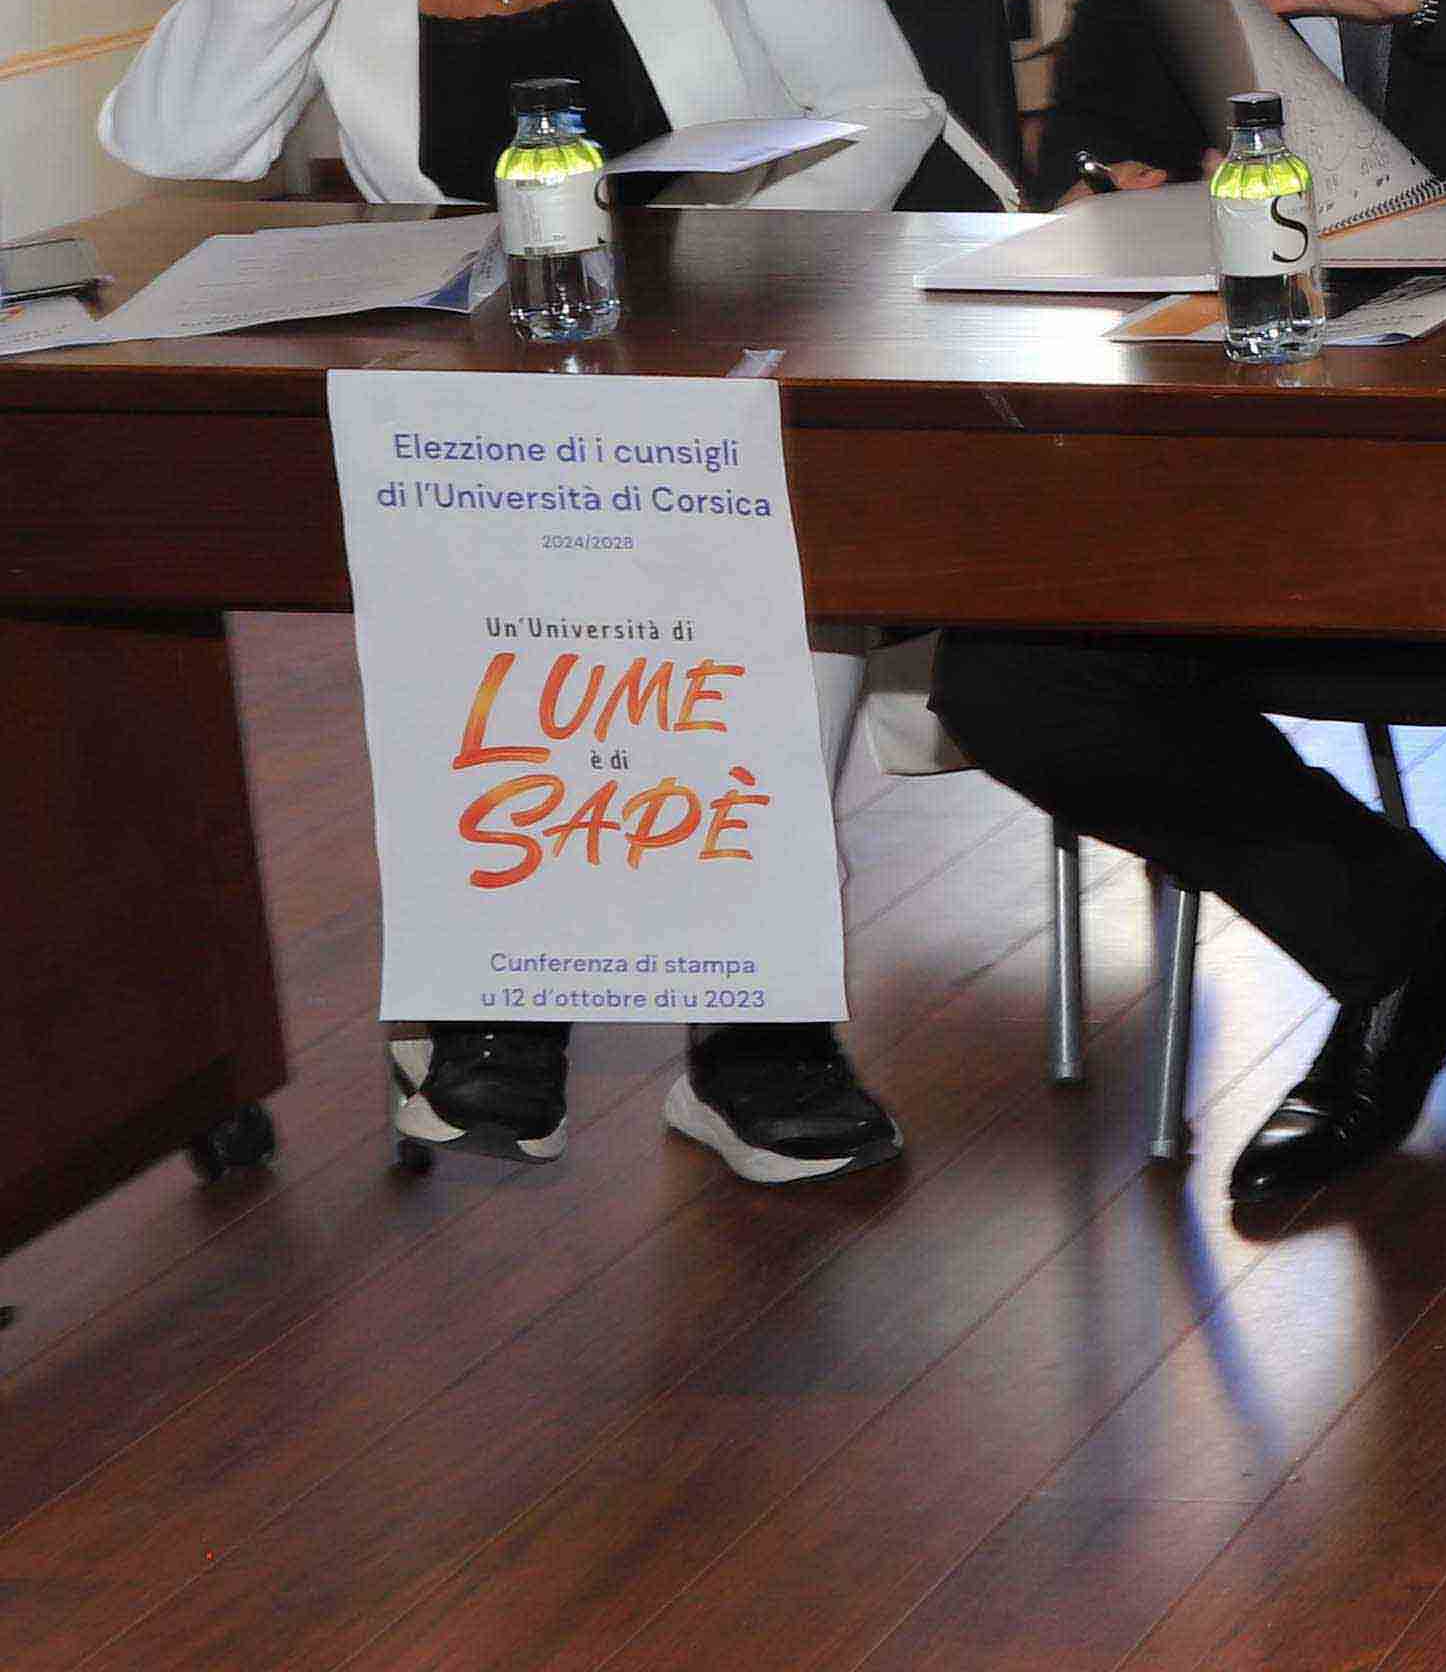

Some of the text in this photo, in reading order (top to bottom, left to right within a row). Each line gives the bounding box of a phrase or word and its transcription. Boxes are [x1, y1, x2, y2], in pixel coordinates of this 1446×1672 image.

[394, 434, 739, 470] Elezzione di i cunsigli
[377, 480, 771, 518] di l'Università di Corsica
[542, 534, 634, 550] 2024/2028
[486, 618, 692, 641] Un'Università di
[453, 653, 744, 769] LUME
[591, 750, 629, 769] è di
[458, 767, 769, 888] SAPÈ
[491, 953, 755, 979] Cunferenza di stampa
[480, 988, 764, 1008] u 12 d'ottobre di u 2023
